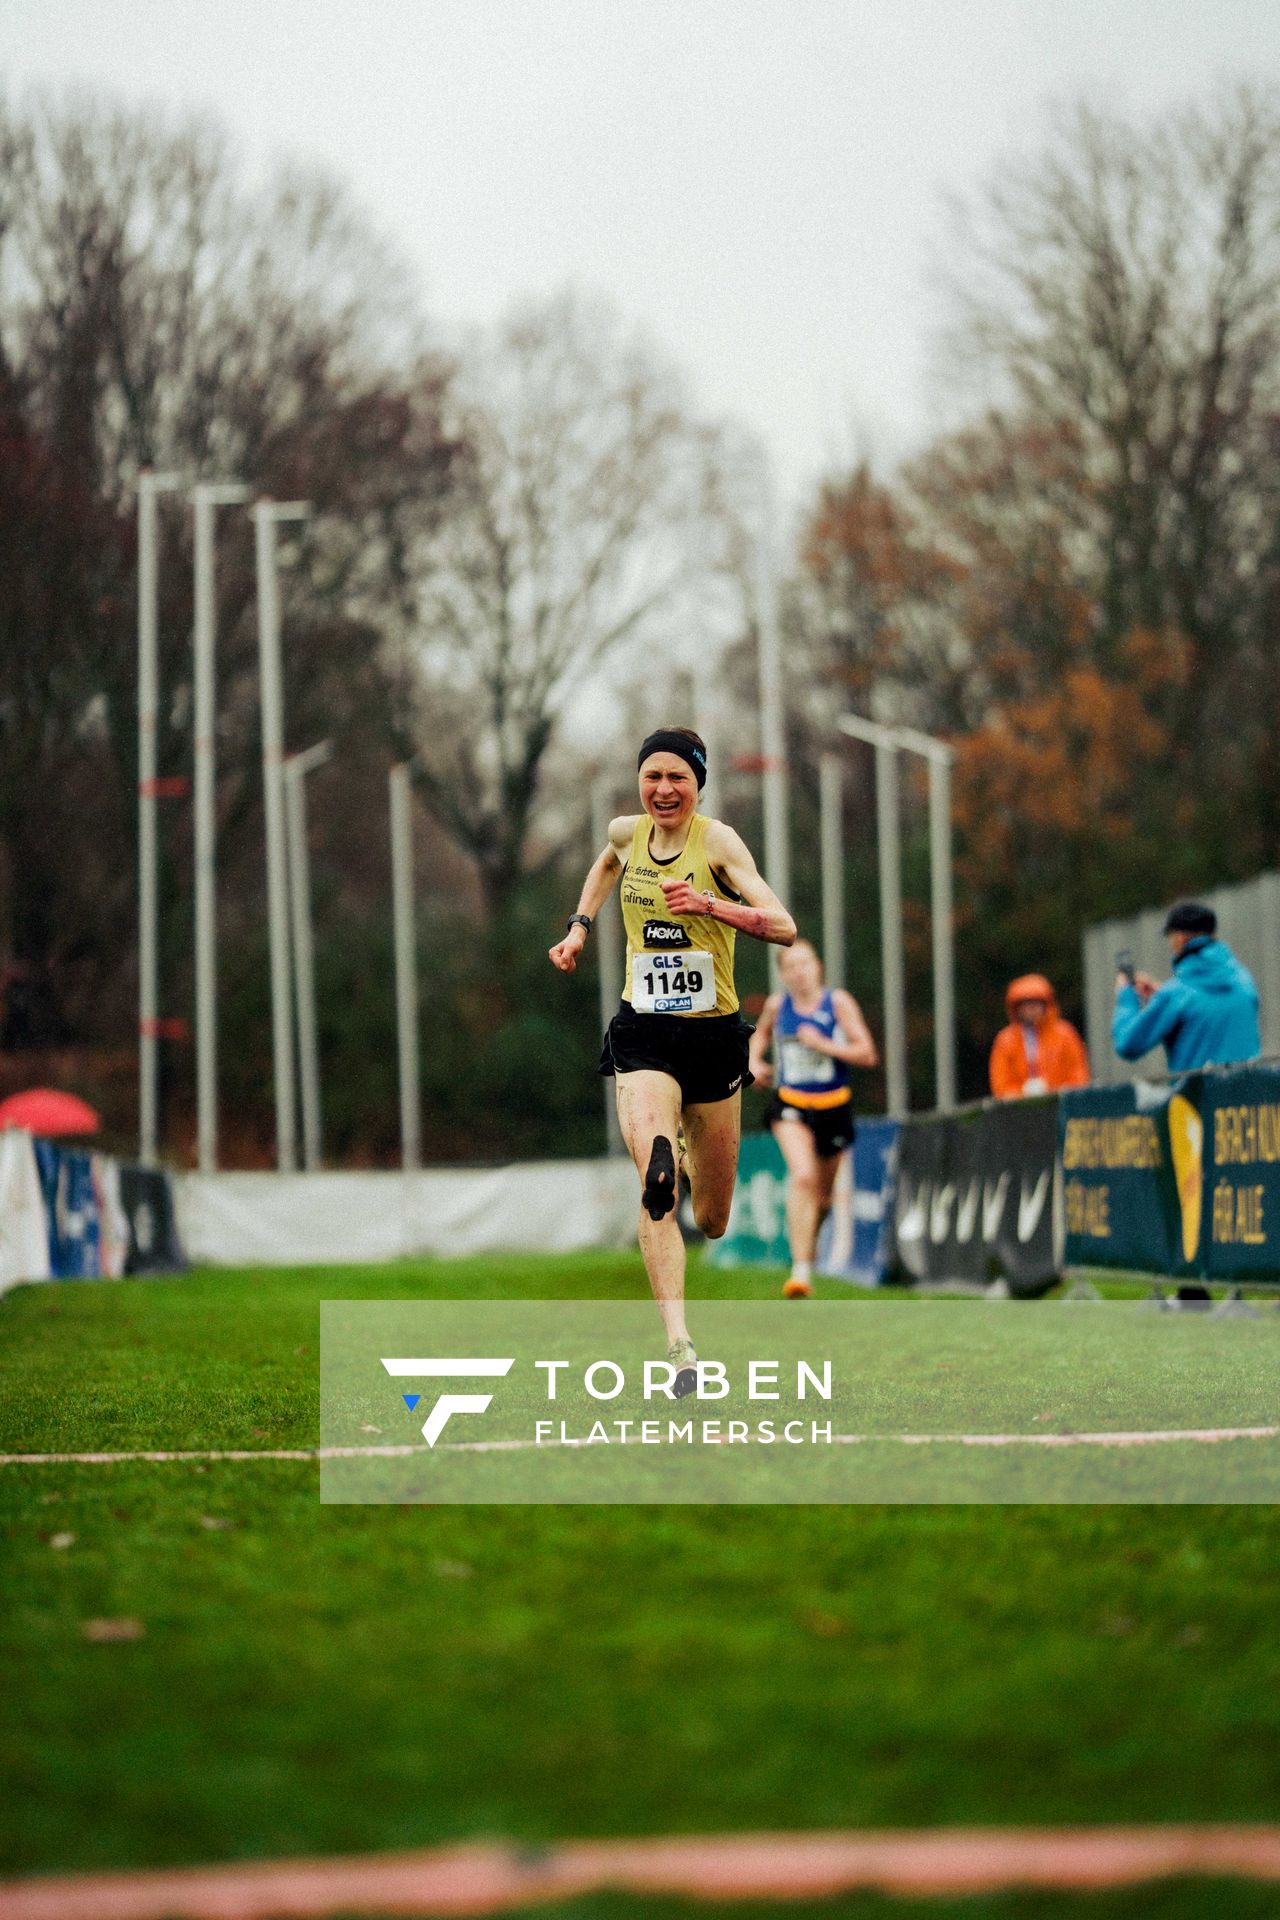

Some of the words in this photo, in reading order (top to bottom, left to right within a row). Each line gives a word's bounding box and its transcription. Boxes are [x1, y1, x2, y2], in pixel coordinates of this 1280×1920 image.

[624, 891, 655, 906] infinex
[646, 926, 683, 940] HOKA
[653, 955, 683, 968] GLS
[643, 970, 703, 995] 1149
[669, 999, 691, 1007] PLAN
